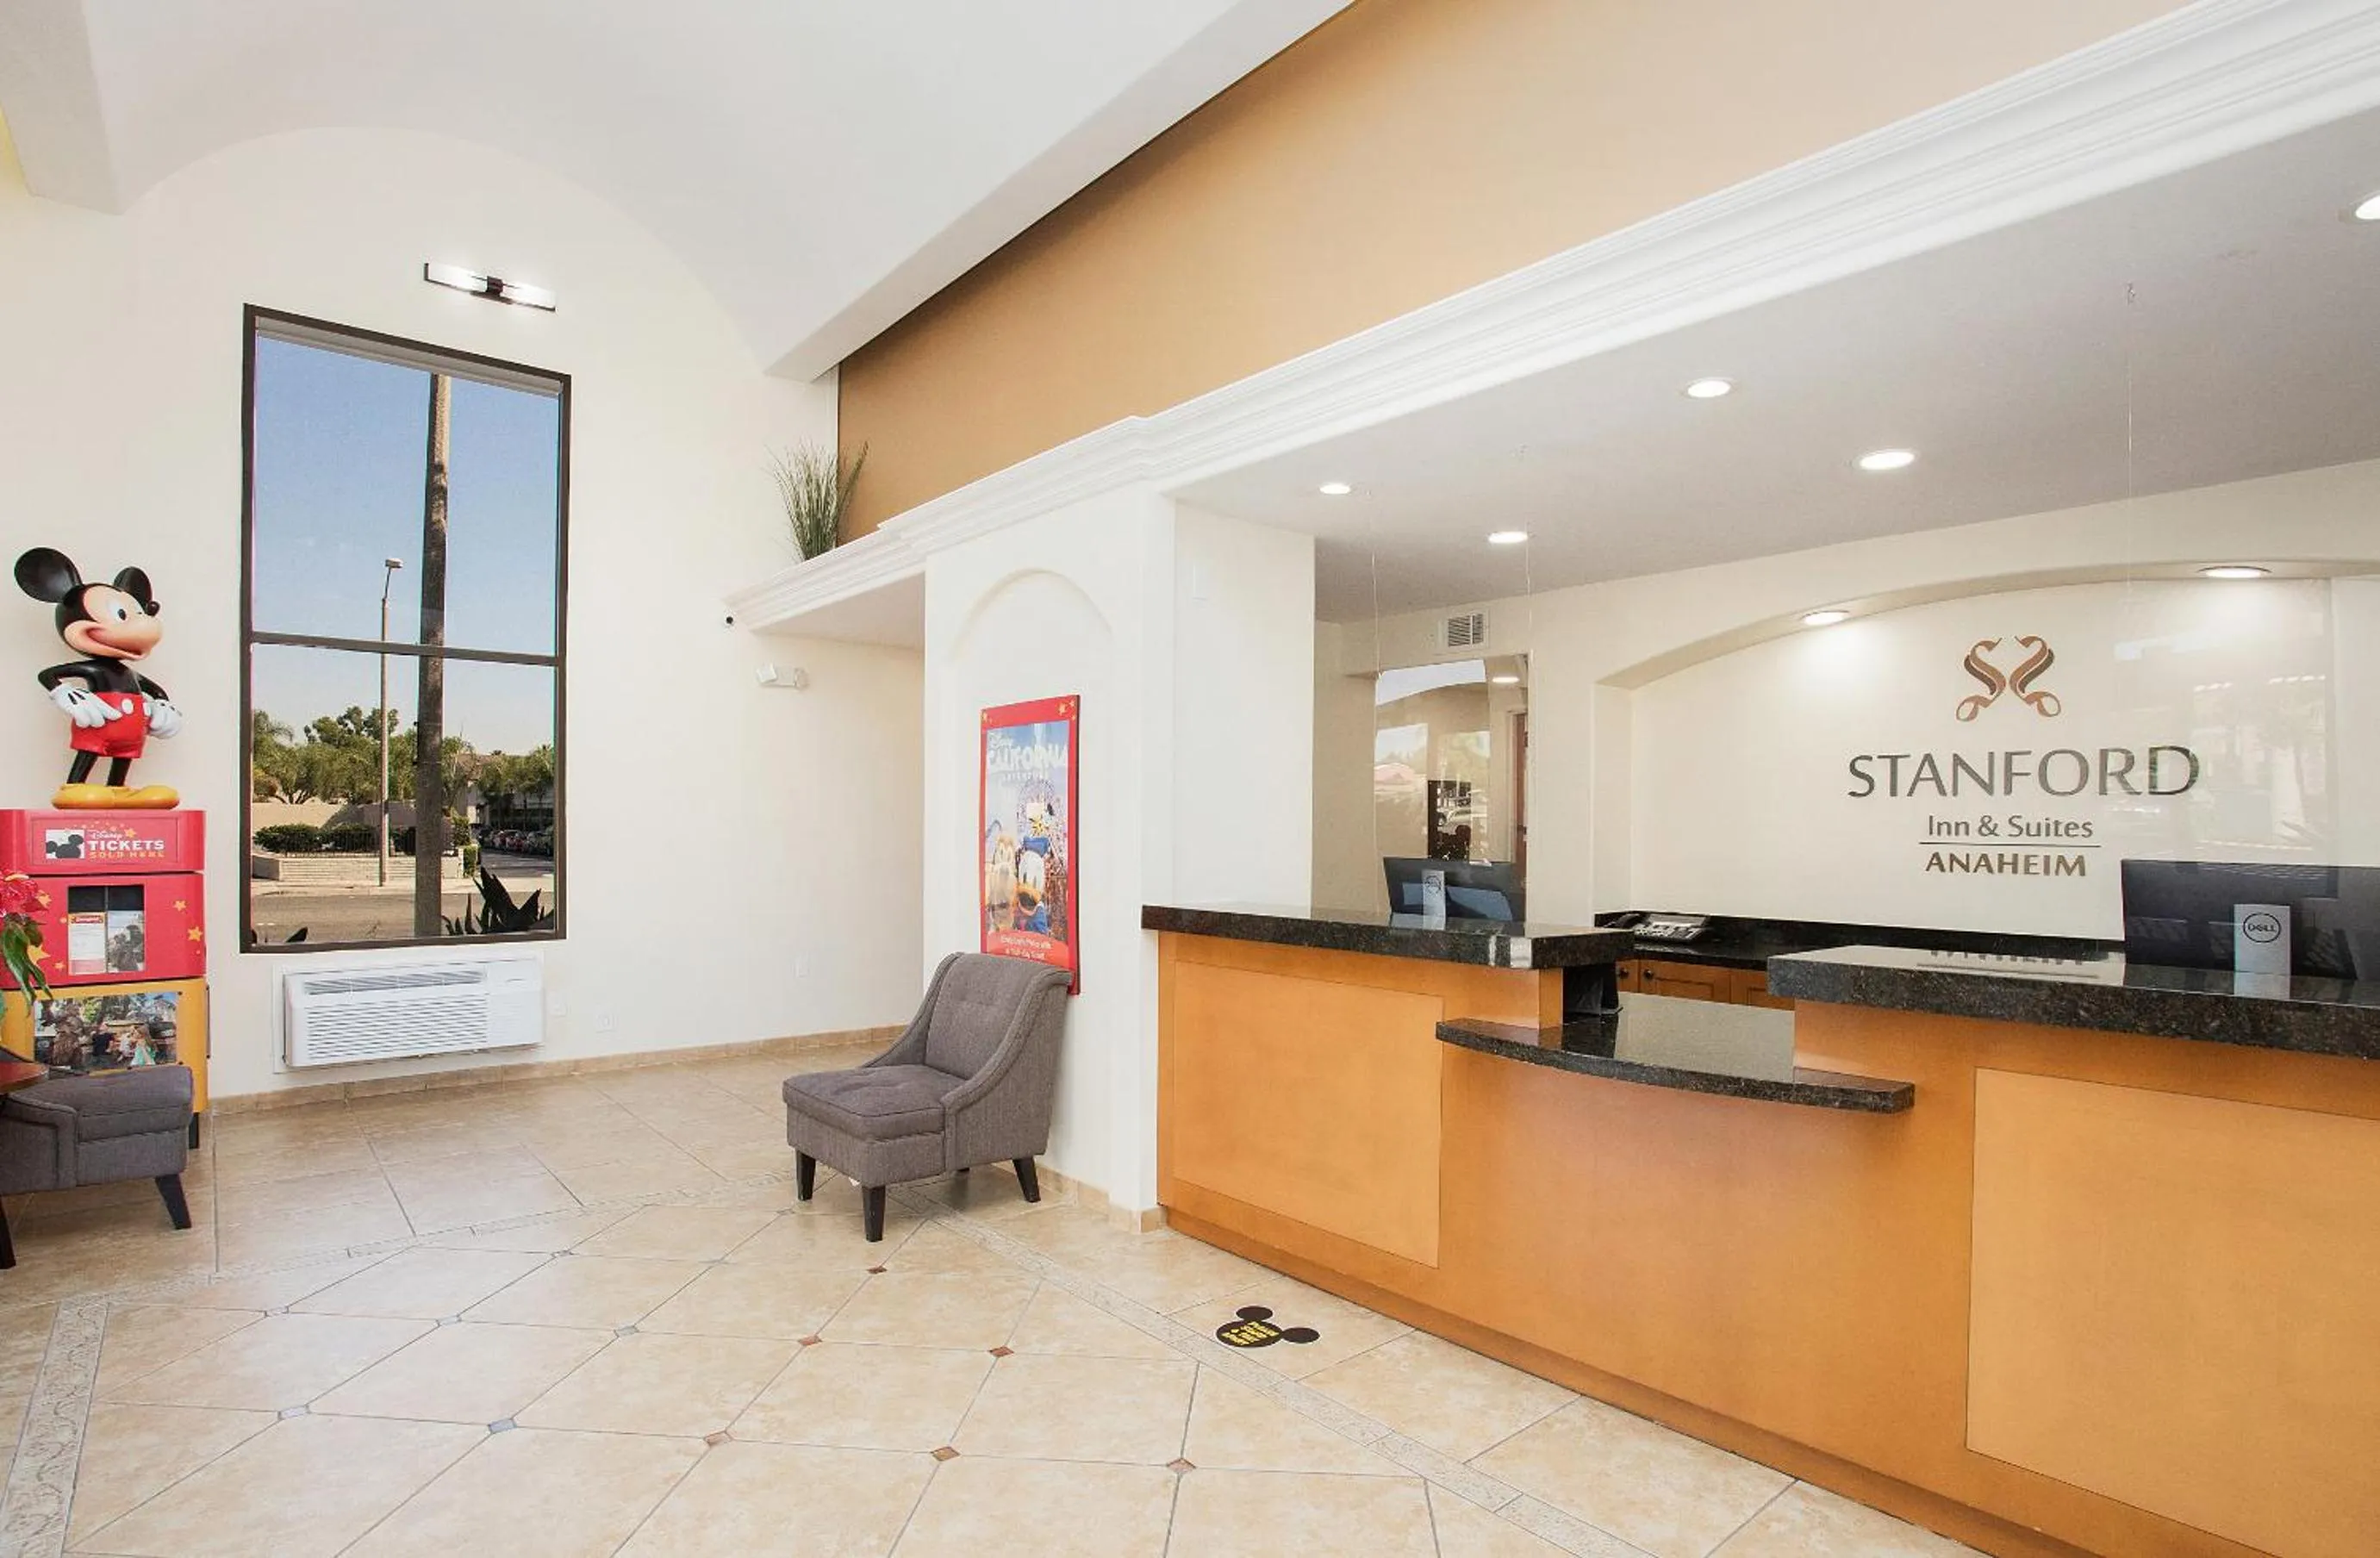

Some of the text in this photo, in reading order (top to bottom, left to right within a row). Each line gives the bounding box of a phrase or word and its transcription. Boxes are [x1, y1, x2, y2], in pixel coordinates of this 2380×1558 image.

[1847, 745, 2200, 798] STANFORD
[1928, 814, 2094, 838] Inn & Suites
[87, 840, 165, 851] TICKETS
[1925, 851, 2086, 876] ANAHEIM
[2247, 923, 2277, 932] DELL
